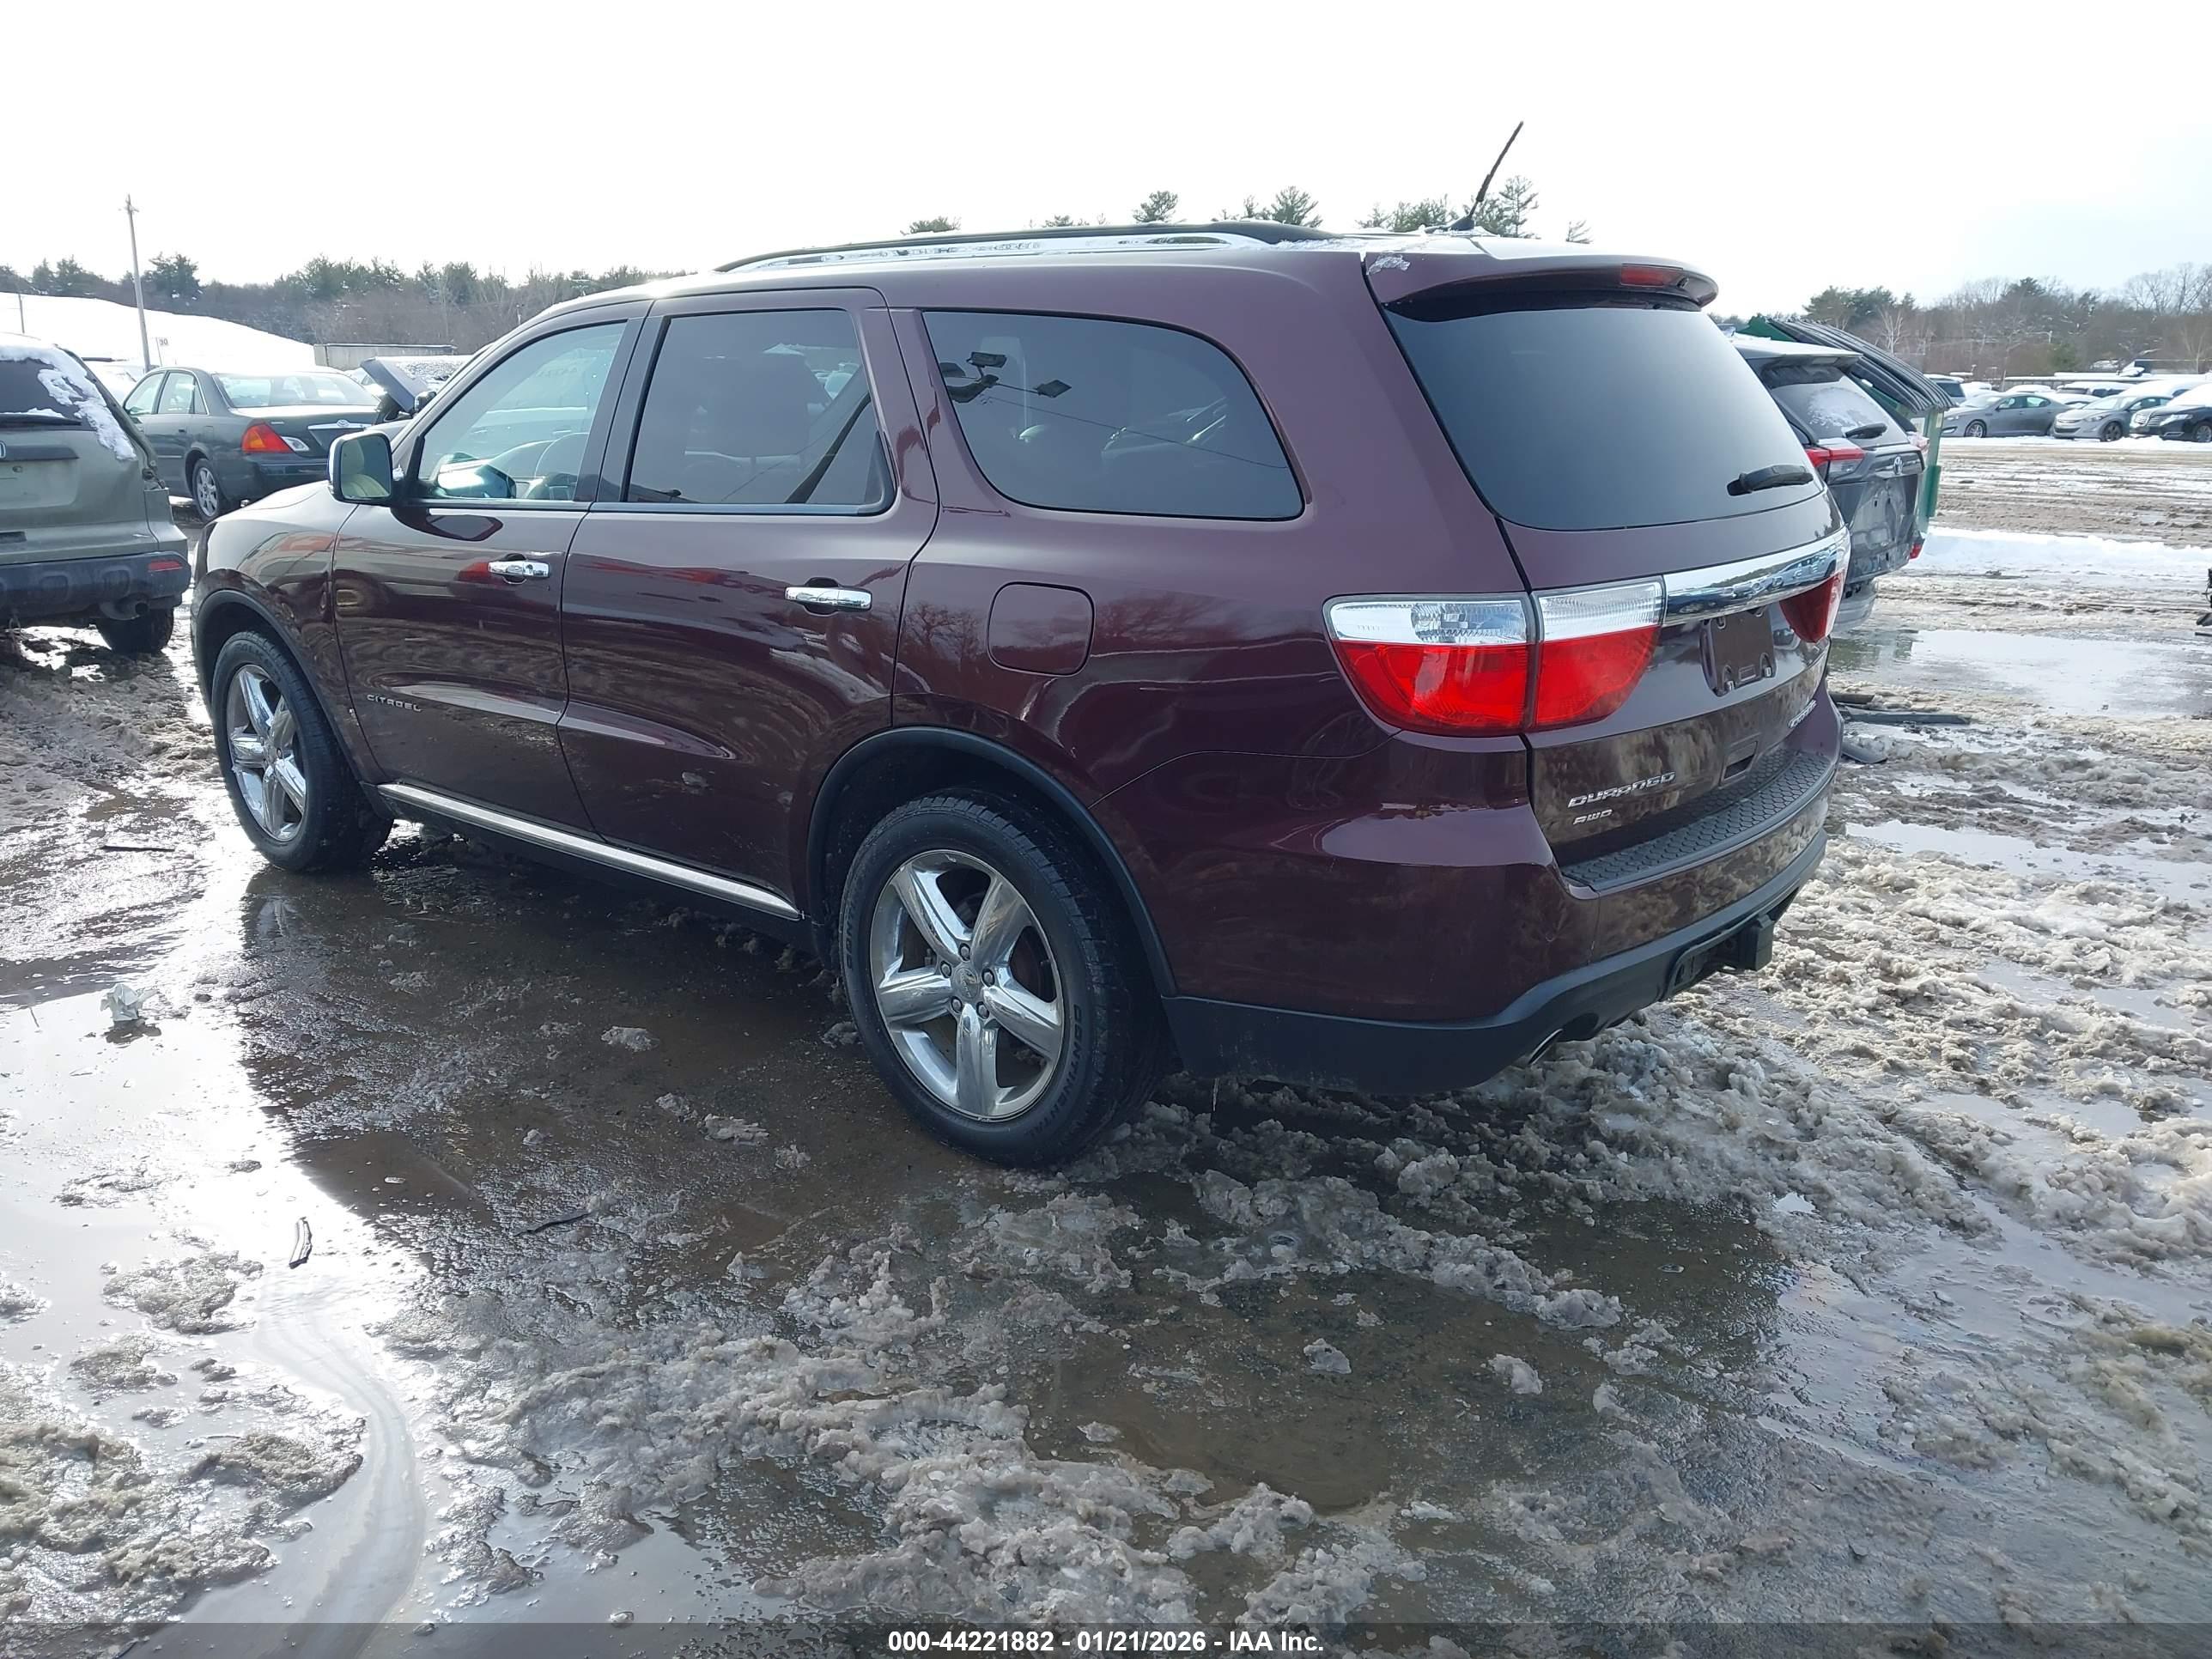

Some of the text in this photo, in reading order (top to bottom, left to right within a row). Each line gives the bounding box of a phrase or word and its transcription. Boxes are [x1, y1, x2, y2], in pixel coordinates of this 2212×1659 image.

[367, 694, 422, 712] CITADEL
[1567, 772, 1675, 808] DURANGO
[1572, 809, 1613, 825] AWD
